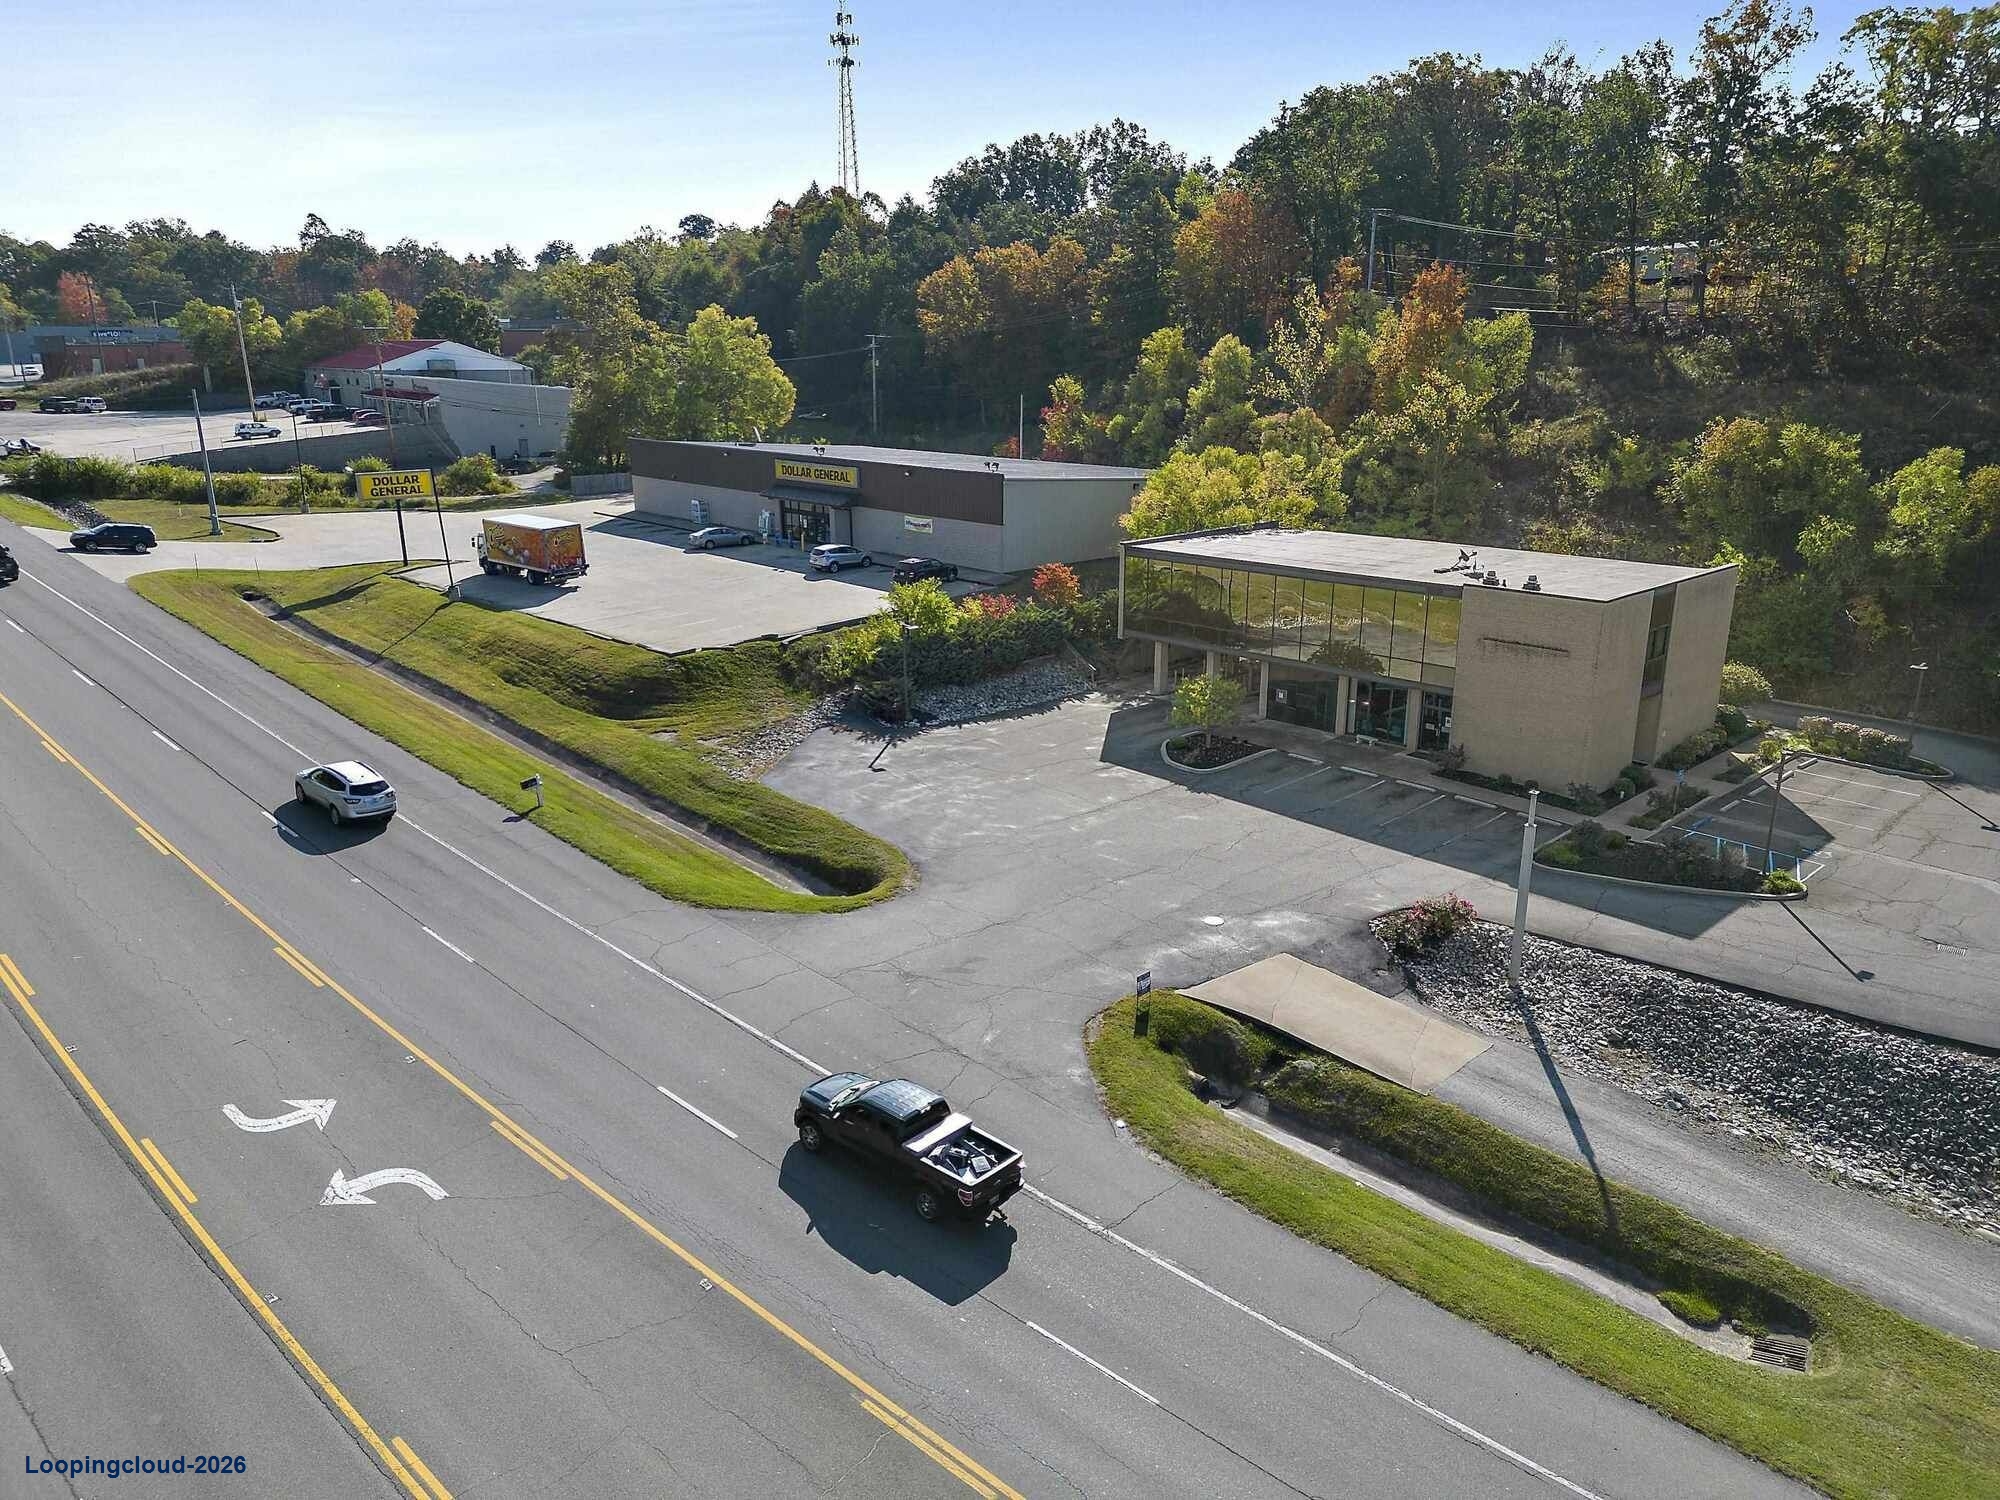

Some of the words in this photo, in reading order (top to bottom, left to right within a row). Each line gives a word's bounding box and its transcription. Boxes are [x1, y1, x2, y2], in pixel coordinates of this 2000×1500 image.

[781, 464, 812, 478] DOLLAR
[813, 468, 851, 483] GENERAL
[372, 474, 419, 486] DOLLAR
[370, 485, 424, 497] GENERAL
